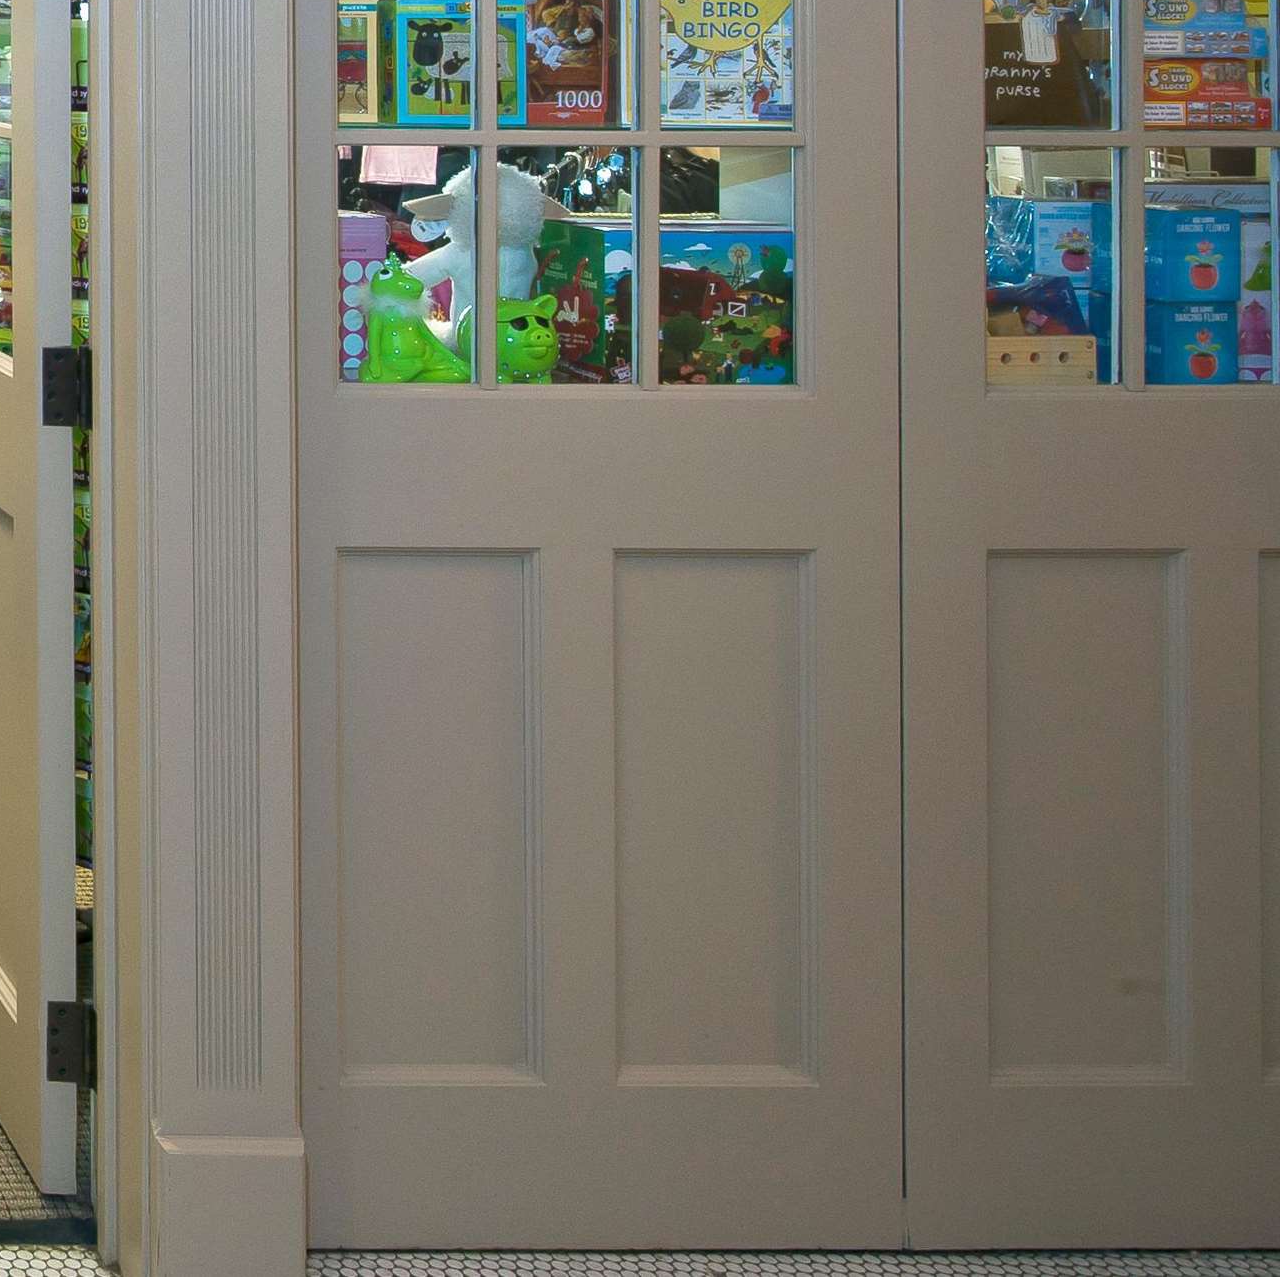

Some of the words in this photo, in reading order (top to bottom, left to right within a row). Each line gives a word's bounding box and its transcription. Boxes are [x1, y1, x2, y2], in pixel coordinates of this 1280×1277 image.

[703, 2, 759, 17] BIRD
[683, 22, 760, 38] BINGO
[1003, 49, 1024, 62] my
[555, 90, 602, 108] 1000
